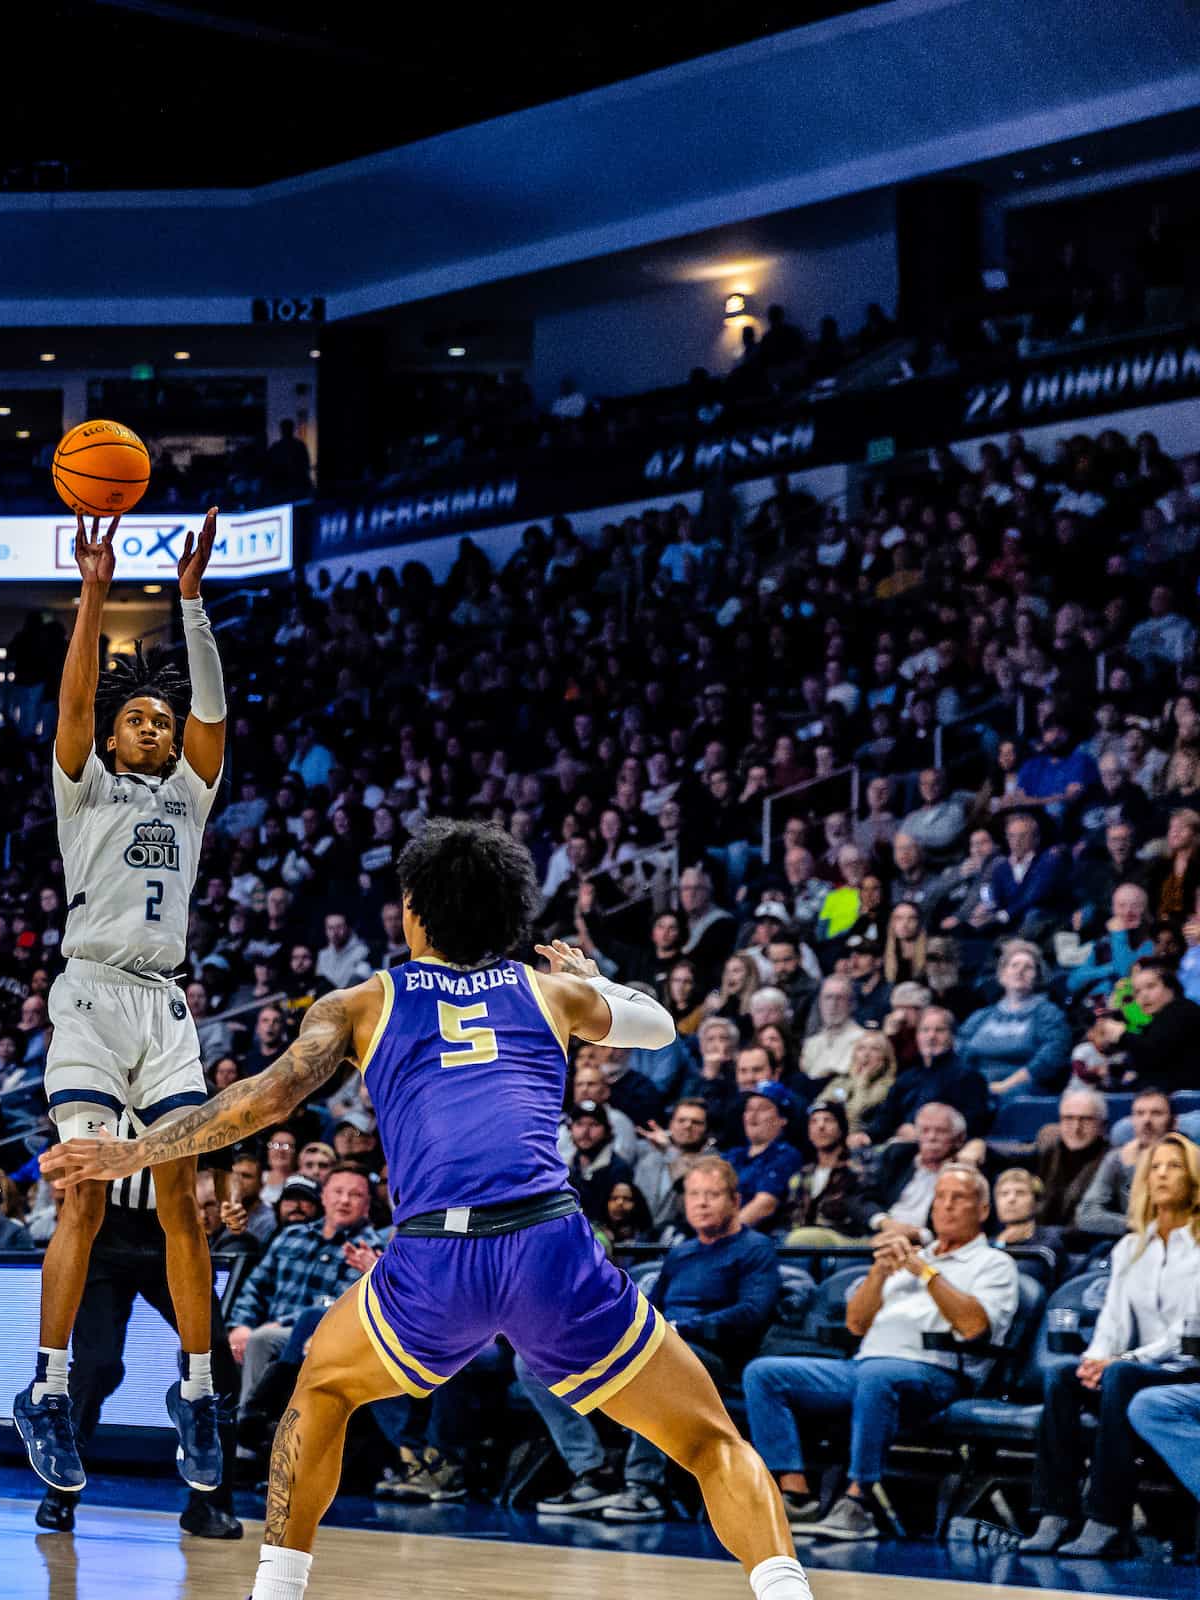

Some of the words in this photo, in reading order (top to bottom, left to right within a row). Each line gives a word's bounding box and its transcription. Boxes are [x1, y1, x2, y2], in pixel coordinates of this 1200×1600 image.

[124, 843, 179, 871] ODU
[145, 880, 163, 921] 2
[405, 967, 519, 996] EDWARDS
[437, 999, 498, 1068] 5
